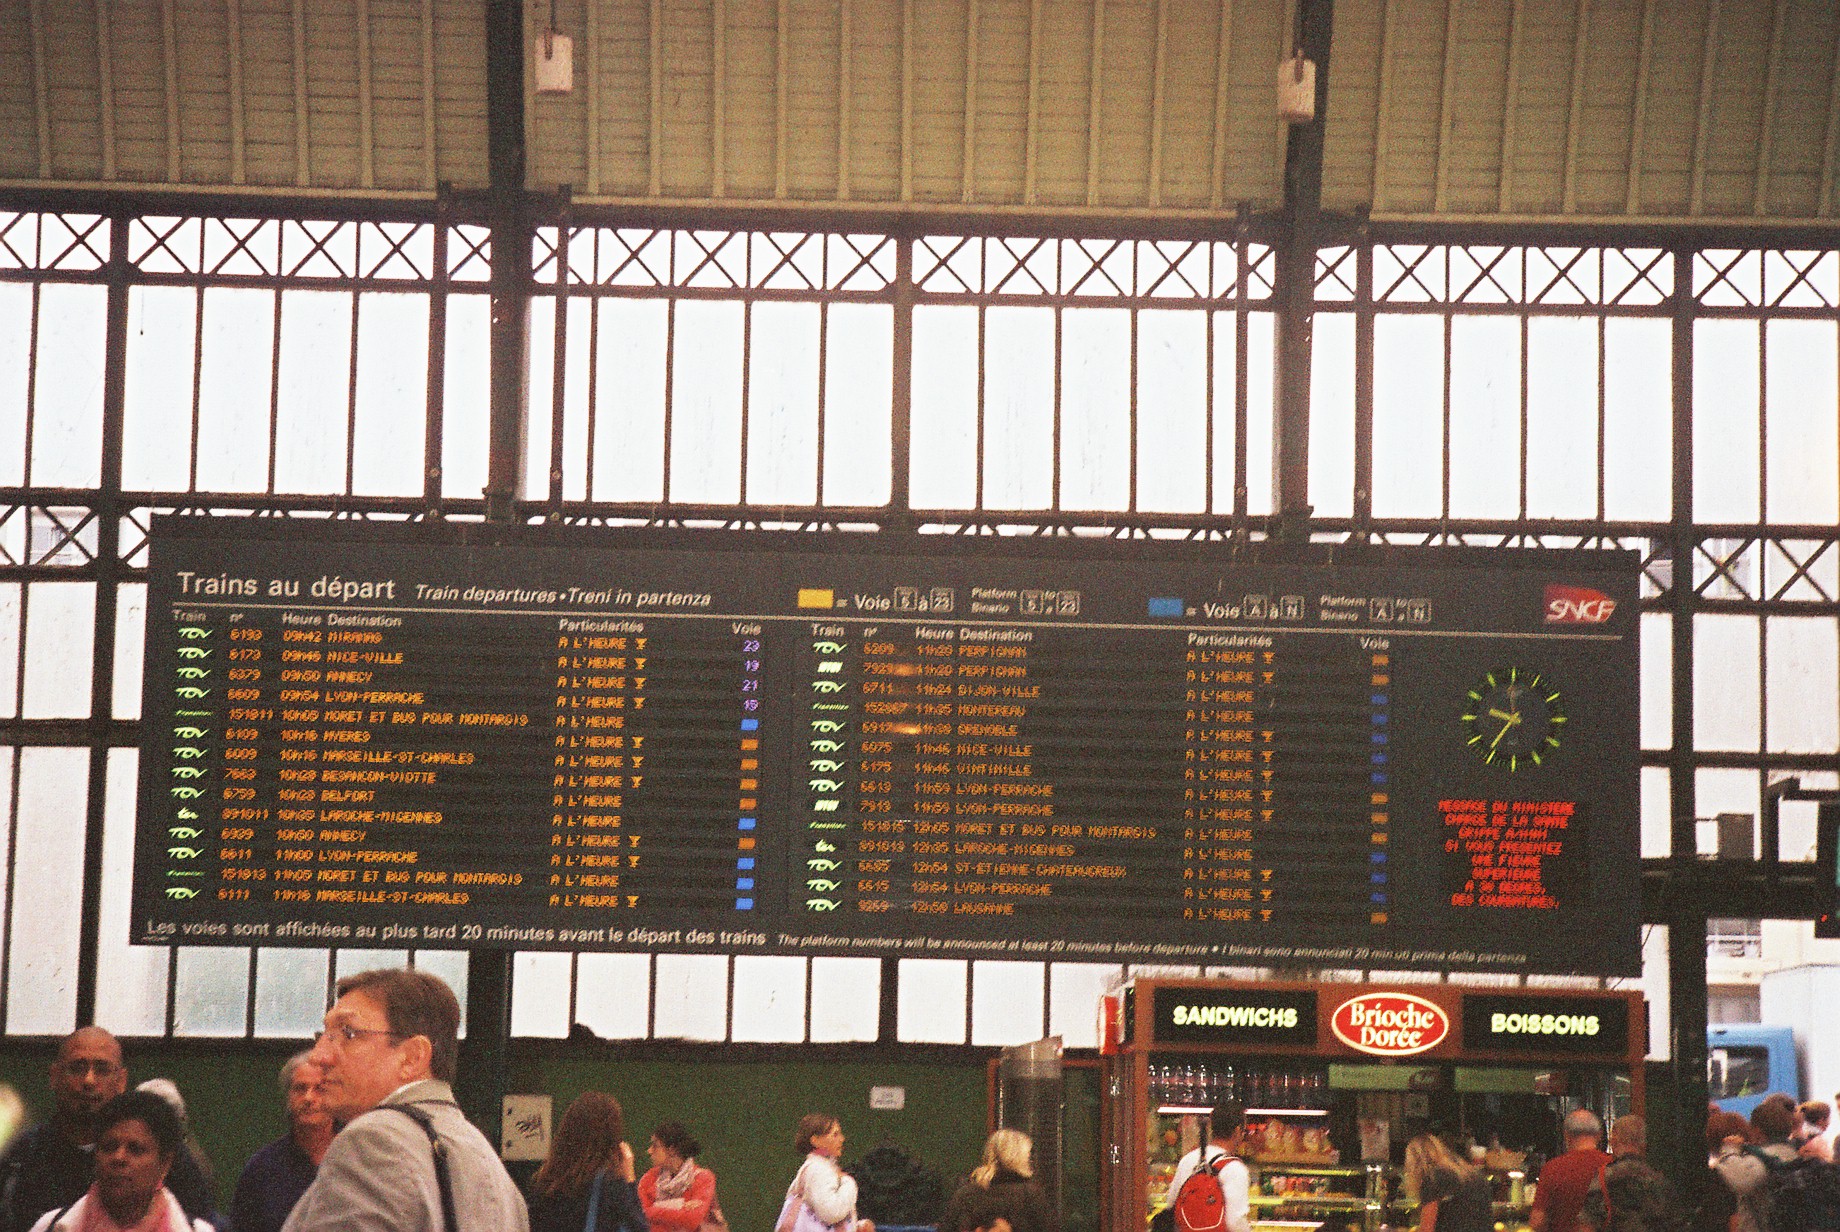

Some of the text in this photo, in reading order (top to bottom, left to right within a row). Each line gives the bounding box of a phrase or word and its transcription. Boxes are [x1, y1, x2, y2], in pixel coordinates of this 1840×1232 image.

[177, 571, 396, 602] Trains au départ
[416, 584, 460, 600] Train
[462, 586, 556, 604] departures
[616, 588, 632, 604] in
[636, 591, 712, 608] partenza
[854, 594, 891, 611] Voie
[1203, 602, 1240, 619] Voie
[1546, 600, 1616, 620] SNCF
[172, 609, 762, 636] Train Heure Destination Particularités Voie
[573, 638, 627, 650] L'HEURE
[811, 624, 1390, 650] Train Heure Destination Particularités Voie
[326, 651, 404, 664] NICE-VILLE
[572, 657, 626, 670] L'HEURE
[326, 670, 373, 683] ANNECY
[572, 676, 626, 689] L'HEURE
[325, 690, 424, 704] LYON-PERRACHE
[571, 696, 625, 709] L'HEURE
[324, 710, 362, 723] MORET
[370, 711, 386, 724] ET
[422, 712, 454, 725] POUR
[459, 713, 529, 726] MONTARGIS
[570, 716, 624, 728] L'HEURE
[570, 736, 624, 748] L'HEURE
[322, 750, 476, 765] MARSEILLE-ST-CHARLES
[570, 756, 624, 768] L'HEURE
[569, 776, 622, 788] L'HEURE
[320, 790, 376, 802] BELFORT
[568, 795, 622, 808] L'HEURE
[567, 815, 621, 828] L'HEURE
[319, 830, 366, 842] ANNECY
[566, 834, 620, 848] L'HEURE
[318, 850, 418, 864] LYON-PERRACHE
[566, 855, 620, 868] L'HEURE
[317, 870, 356, 883] MORET
[363, 870, 380, 883] ET
[415, 871, 448, 884] POUR
[452, 872, 523, 886] MONTARGIS
[565, 875, 619, 888] L'HEURE
[316, 890, 470, 904] MARSEILLE-ST-CHARLES
[564, 895, 618, 908] L'HEURE
[147, 920, 766, 946] Les voies sont affichées au plus tard 20 minutes avant le départ des trains
[1173, 1005, 1298, 1028] SANDWICHS
[1350, 1002, 1434, 1028] Brioche
[1490, 1013, 1600, 1036] BOISSONS
[1360, 1025, 1424, 1048] Dorée
